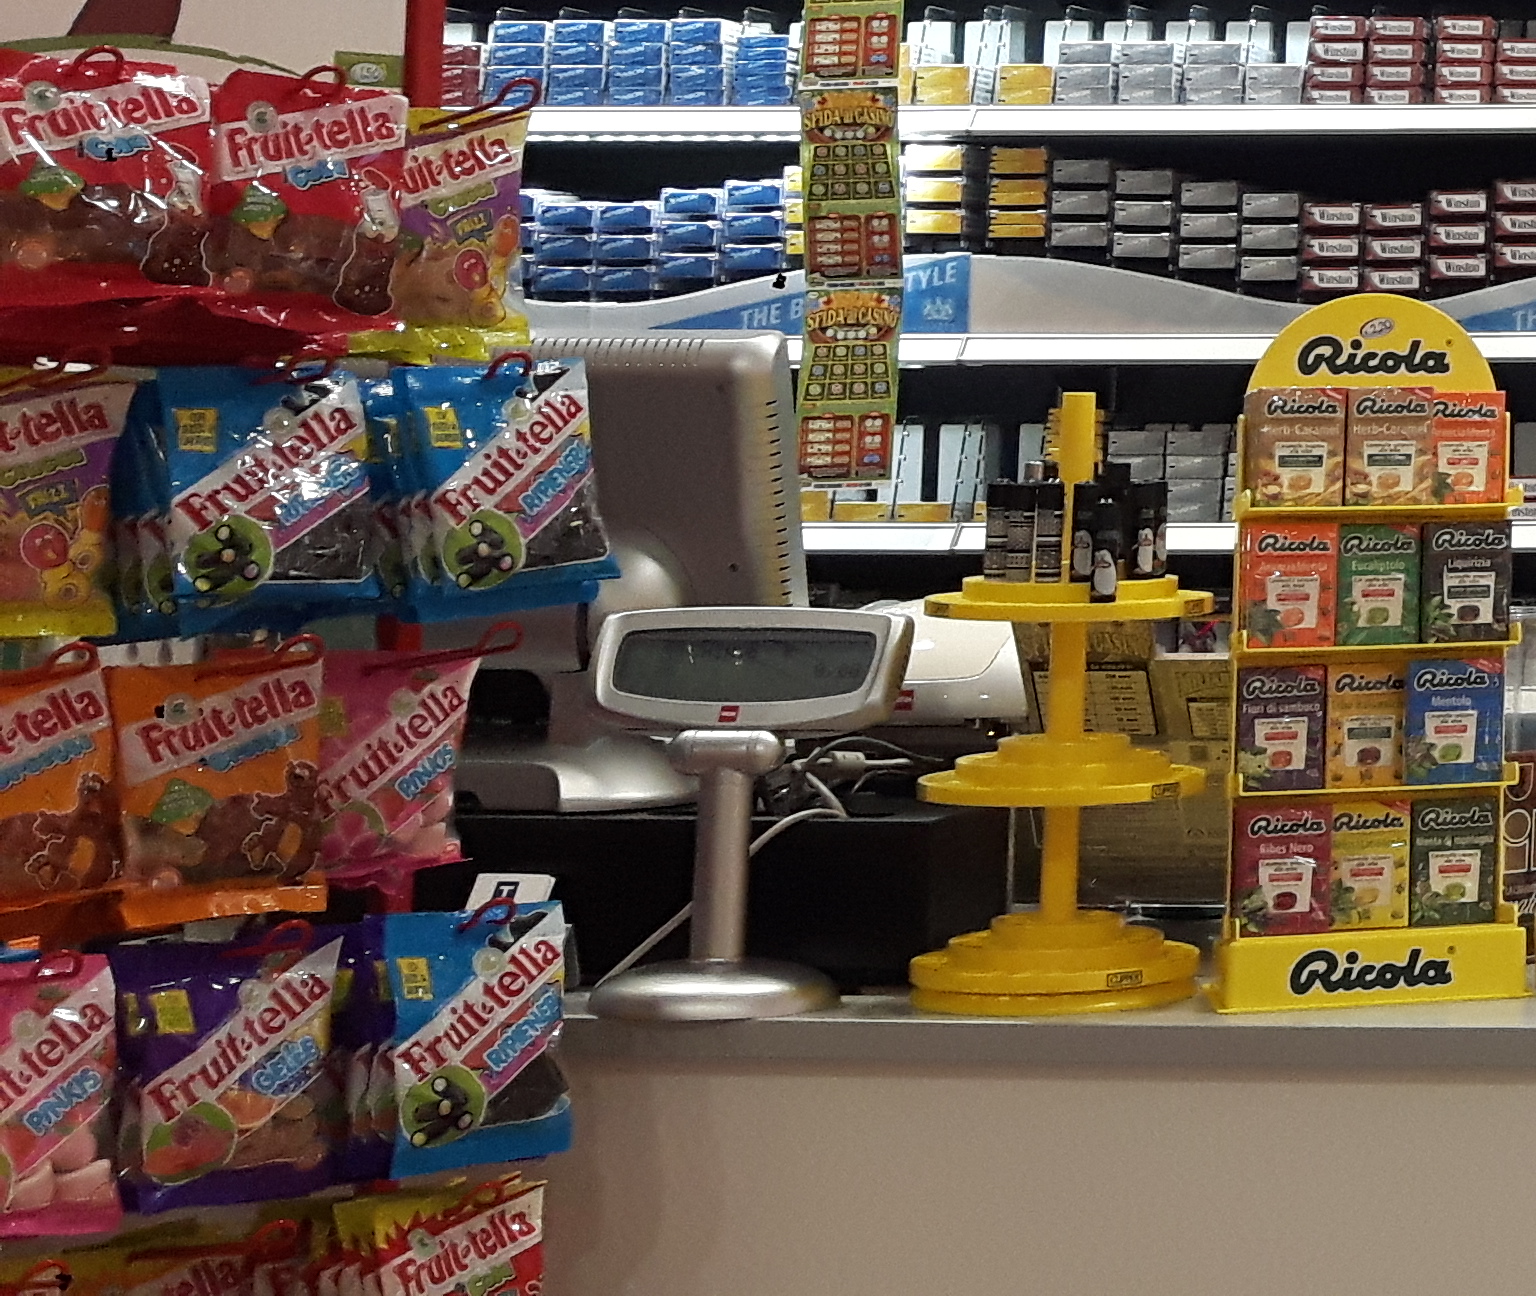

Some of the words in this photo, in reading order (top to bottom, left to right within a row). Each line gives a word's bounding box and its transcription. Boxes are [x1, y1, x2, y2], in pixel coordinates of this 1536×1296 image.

[739, 307, 780, 328] THE
[1297, 334, 1450, 376] Ricola
[1266, 397, 1340, 417] Ricola
[1355, 396, 1427, 417] Ricola
[1433, 400, 1498, 420] Ricola
[1257, 533, 1331, 554] Ricola
[1340, 534, 1415, 554] Ricola
[1433, 530, 1506, 550] Ricola
[1243, 676, 1321, 697] Ricola
[1335, 673, 1405, 693] Ricola
[1414, 669, 1488, 689] Ricola
[1249, 813, 1325, 836] Ricola
[1333, 812, 1404, 832] Ricola
[1418, 808, 1492, 830] Ricola
[1289, 948, 1453, 996] Ricola
